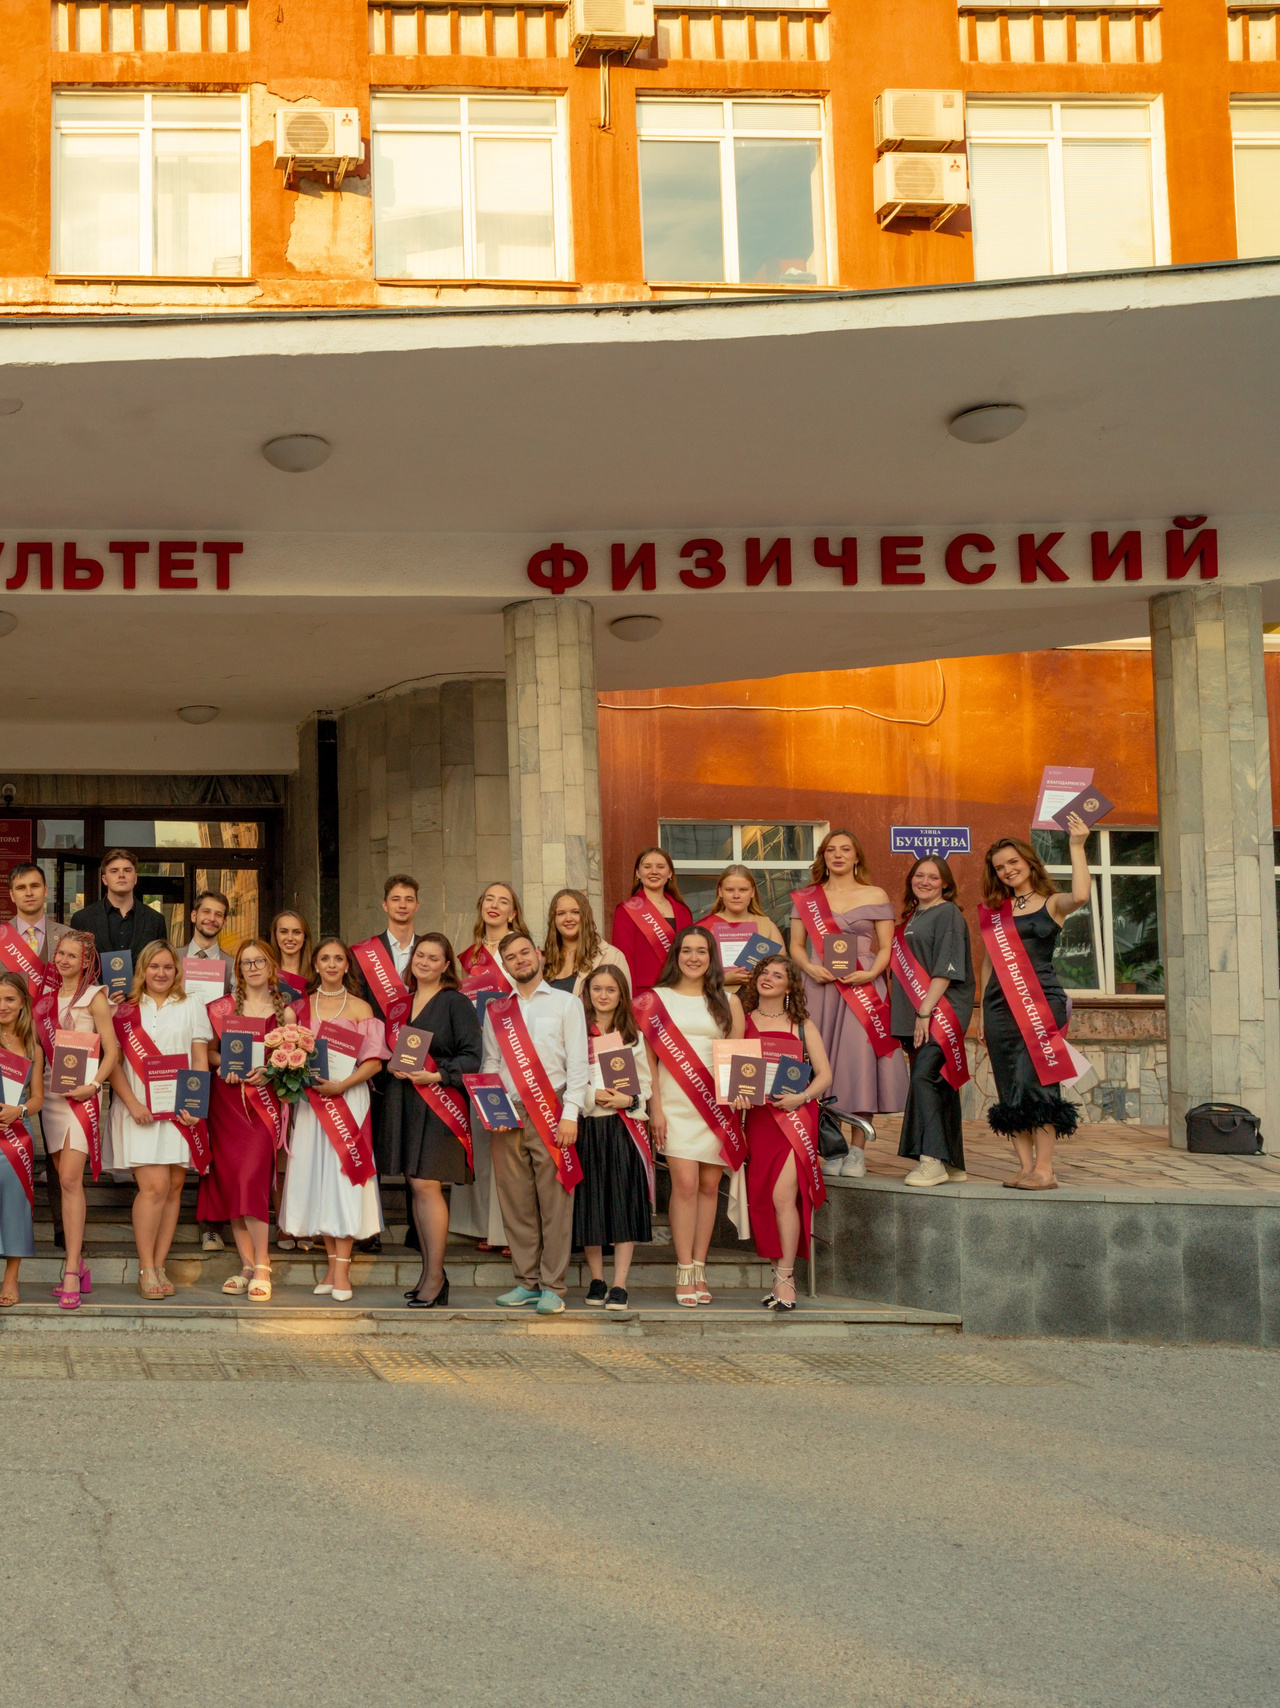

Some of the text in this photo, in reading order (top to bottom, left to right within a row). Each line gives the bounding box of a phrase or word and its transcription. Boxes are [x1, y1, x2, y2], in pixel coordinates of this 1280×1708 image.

[526, 515, 1219, 595] ФИЗИЧЕСКИЙ
[895, 836, 967, 847] БУКИРЕВА
[806, 900, 830, 939] ЛУЧШИ
[5, 943, 44, 987] ЛУЧШИЙ
[366, 949, 399, 998] ЛУЧШИЙ
[991, 913, 1059, 1067] ЛУЧШИЙ ВЫПУСКНИК 2024
[123, 1021, 149, 1060] ЛУЧШИ
[870, 1013, 888, 1039] 2024
[910, 978, 958, 1048] ВЫПСКНИК
[951, 1047, 962, 1072] 2024
[502, 1016, 531, 1067] ЛУЧШИЙ
[561, 1147, 573, 1172] 2024
[648, 1014, 740, 1151] ЛУЧШИЙ ВЫПУСКНИК 2024
[428, 1082, 469, 1131] ПУСКНИК
[192, 1132, 204, 1156] 2024
[346, 1141, 363, 1168] 2024
[811, 1164, 820, 1190] 2024
